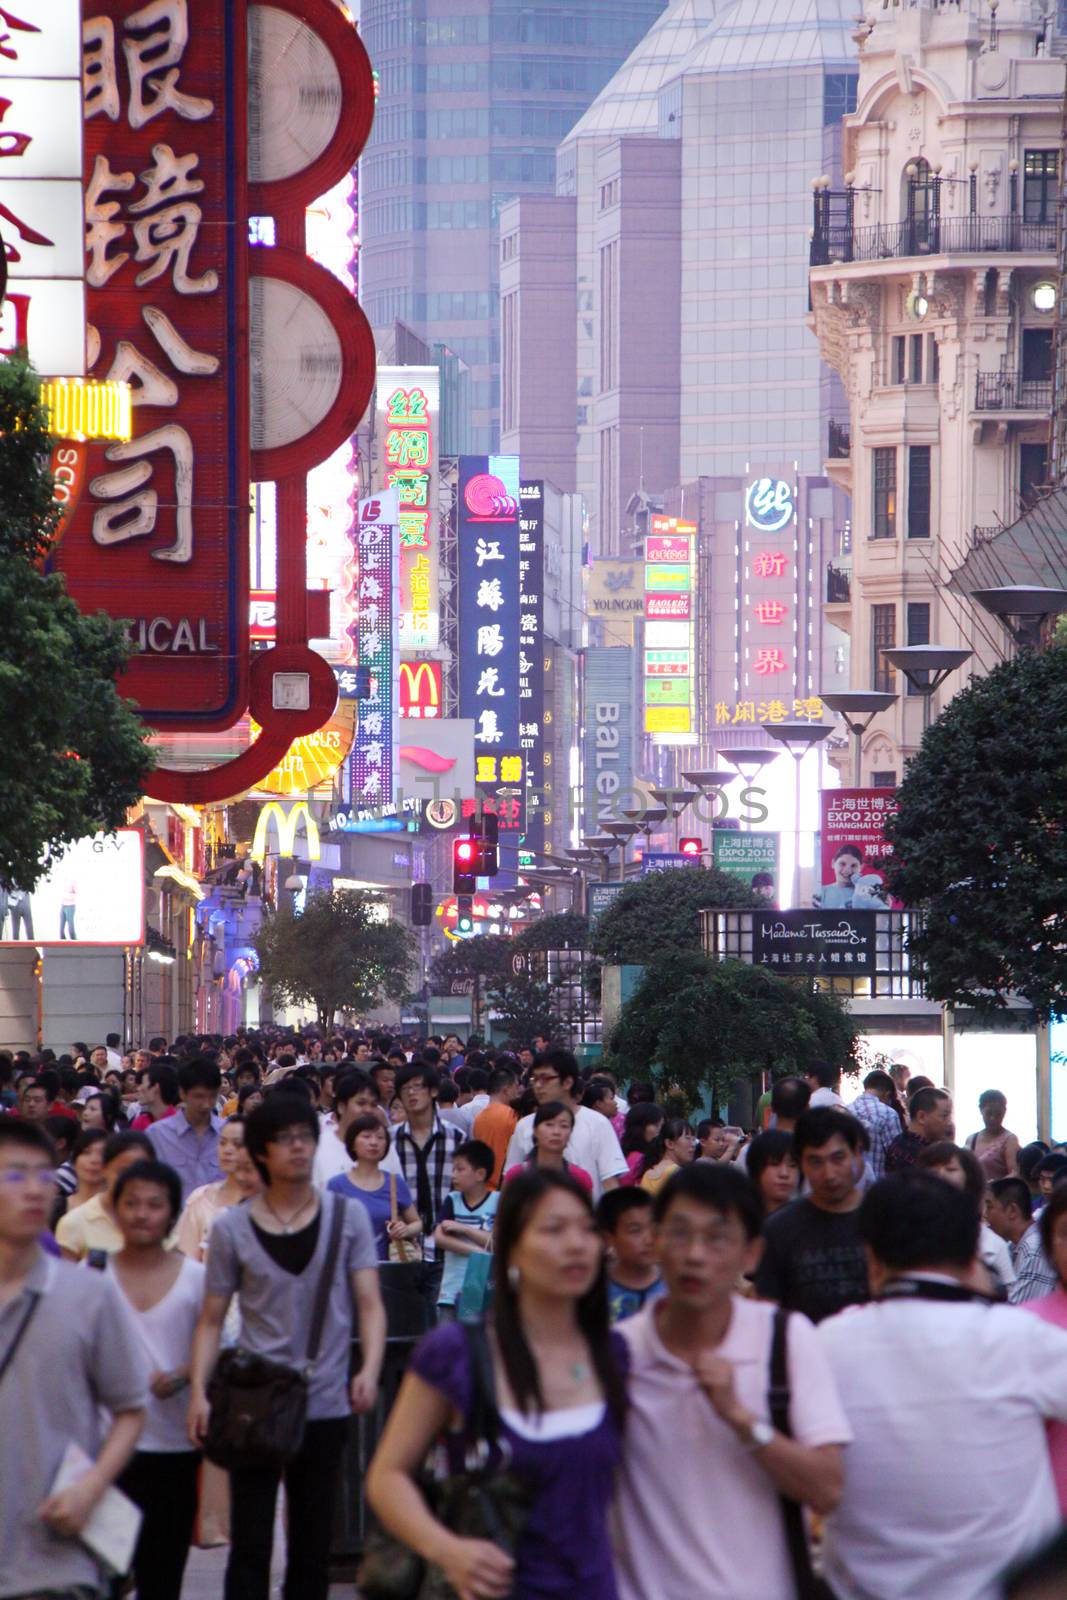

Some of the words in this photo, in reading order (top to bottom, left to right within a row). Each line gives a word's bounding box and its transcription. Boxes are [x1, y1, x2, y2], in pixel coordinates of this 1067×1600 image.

[753, 551, 786, 675] 新世界
[715, 697, 824, 724] 休闲港湾
[828, 812, 861, 822] EXPO
[719, 838, 776, 848] 上海世博会
[719, 849, 746, 857] EXPO
[747, 849, 776, 857] 2010
[761, 922, 808, 940] Madame
[803, 921, 860, 945] Tussauds
[760, 952, 867, 963] 上海杜莎夫人蜡像馆
